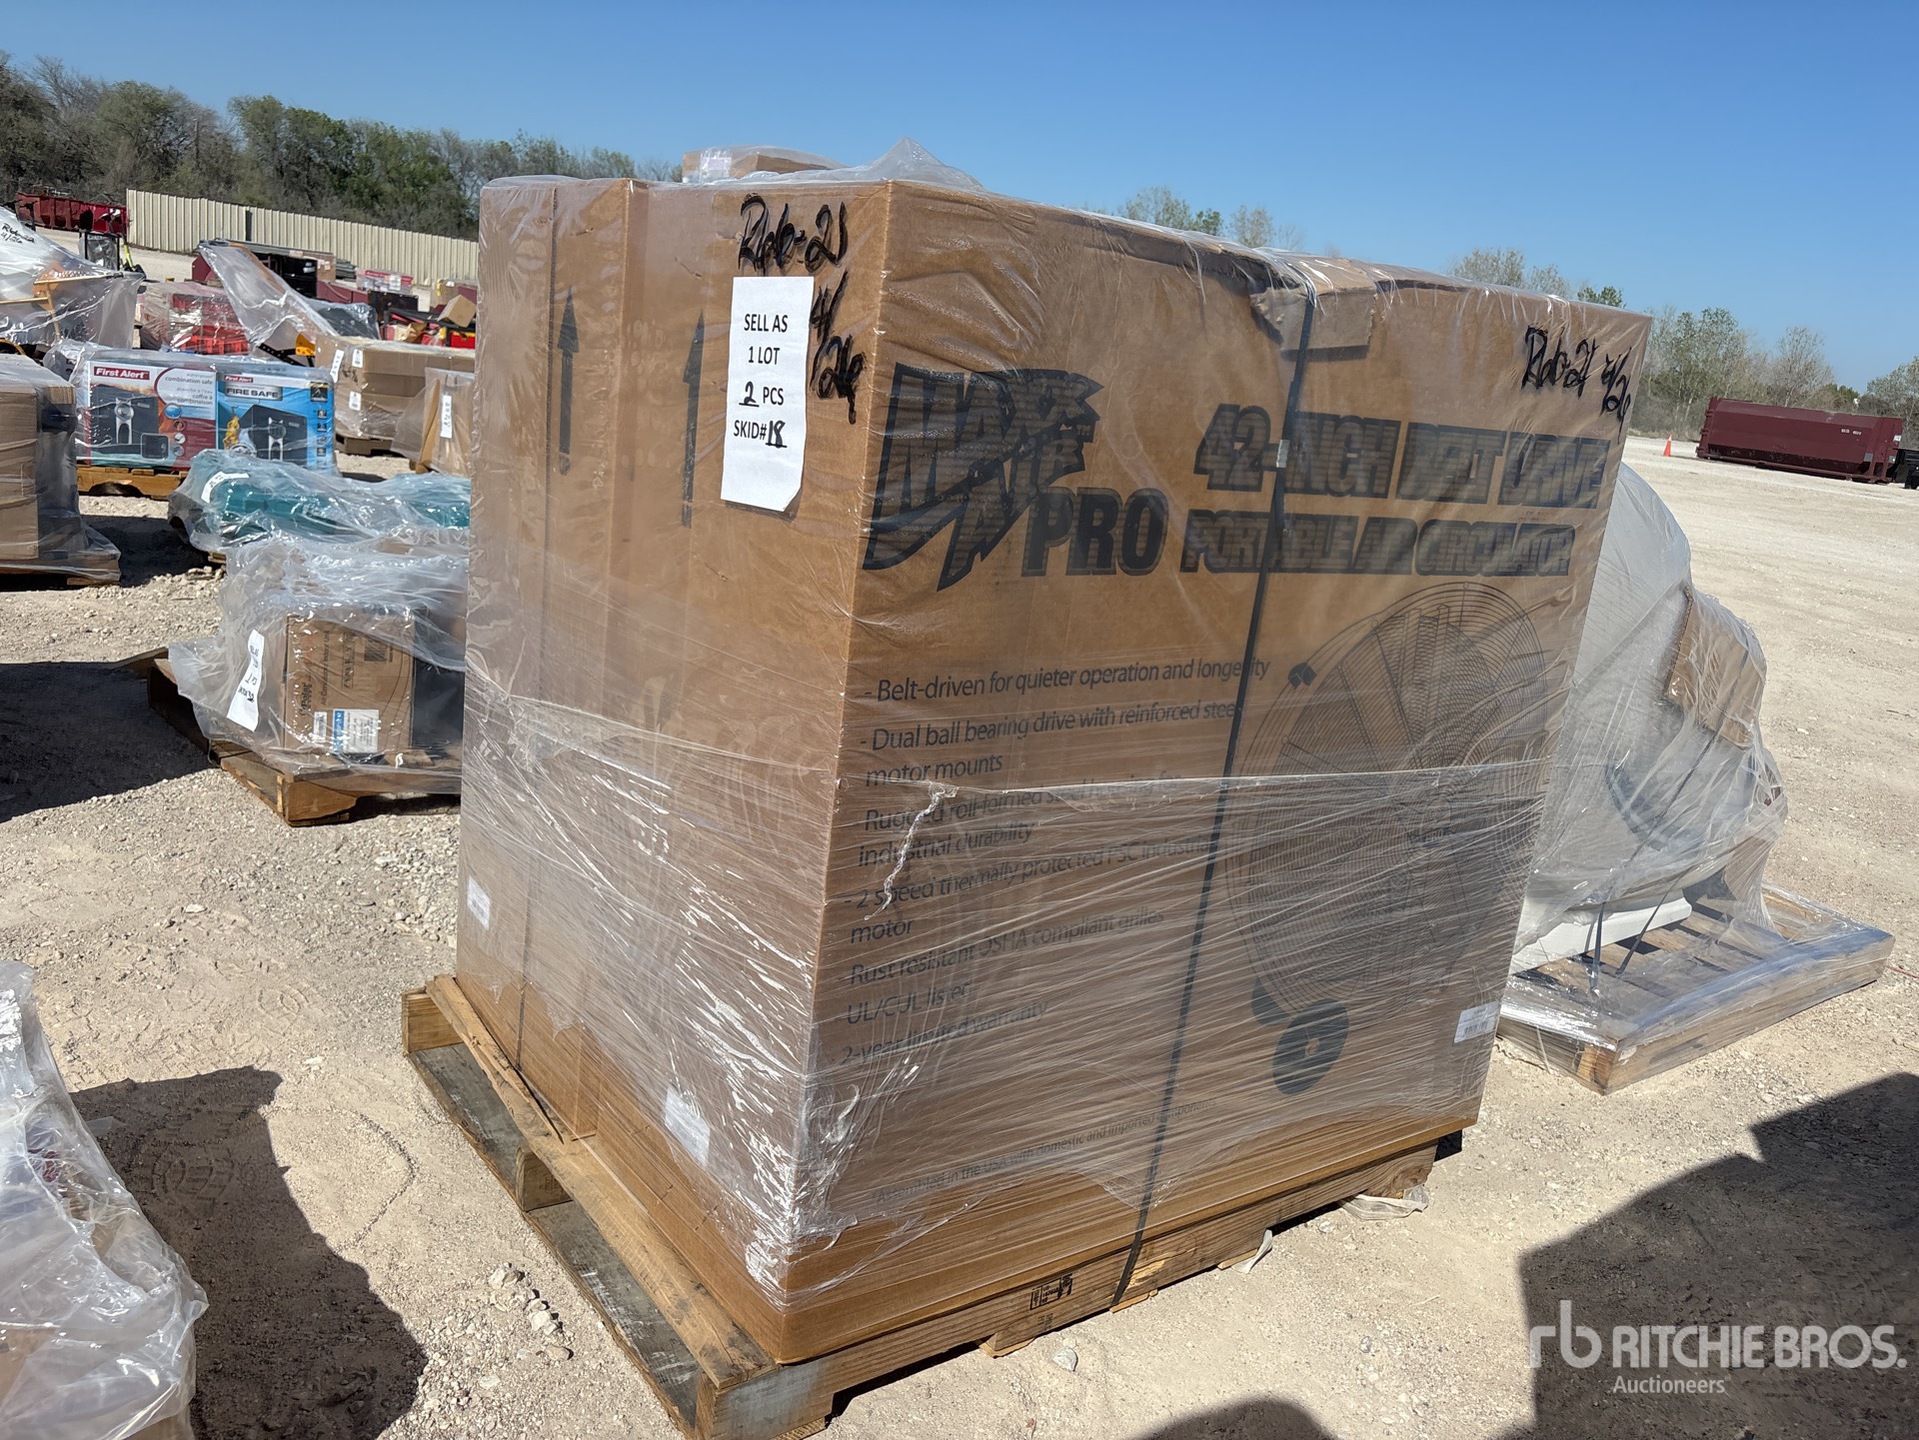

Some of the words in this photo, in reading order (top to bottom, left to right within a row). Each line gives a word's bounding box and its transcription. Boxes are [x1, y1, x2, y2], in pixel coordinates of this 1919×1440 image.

[743, 313, 770, 332] SELL
[771, 314, 789, 333] AS
[747, 345, 755, 364] 1
[757, 346, 781, 366] LOT
[95, 367, 121, 377] First
[122, 370, 146, 380] Alert
[164, 376, 201, 384] combination
[226, 387, 250, 396] FIRE
[250, 389, 279, 398] SAFE
[741, 380, 758, 406] 2
[762, 386, 785, 406] PCS
[1396, 421, 1508, 505] BELT
[1497, 430, 1612, 510] DRIVE
[1021, 486, 1169, 577] PRO
[1415, 518, 1576, 578] CIRCULATOR
[877, 675, 985, 702] Belt-driven
[989, 670, 1013, 694] for
[1015, 667, 1077, 695] quieter
[1079, 661, 1159, 690] operation
[1162, 658, 1195, 680] and
[1196, 655, 1271, 683] longeity
[872, 724, 922, 751] Dual
[925, 720, 961, 747] ball
[964, 715, 1030, 743] bearing
[1033, 710, 1076, 733] drive
[1079, 705, 1116, 728] with
[1119, 698, 1201, 725] reinforced
[1203, 701, 1236, 720] stee
[865, 763, 931, 787] motor
[934, 754, 1004, 780] mounts
[857, 889, 869, 909] 2
[939, 860, 1019, 896] thermally
[1022, 846, 1104, 883] protected
[850, 919, 914, 944] motor
[850, 963, 897, 985] Rust
[899, 944, 977, 977] resistant
